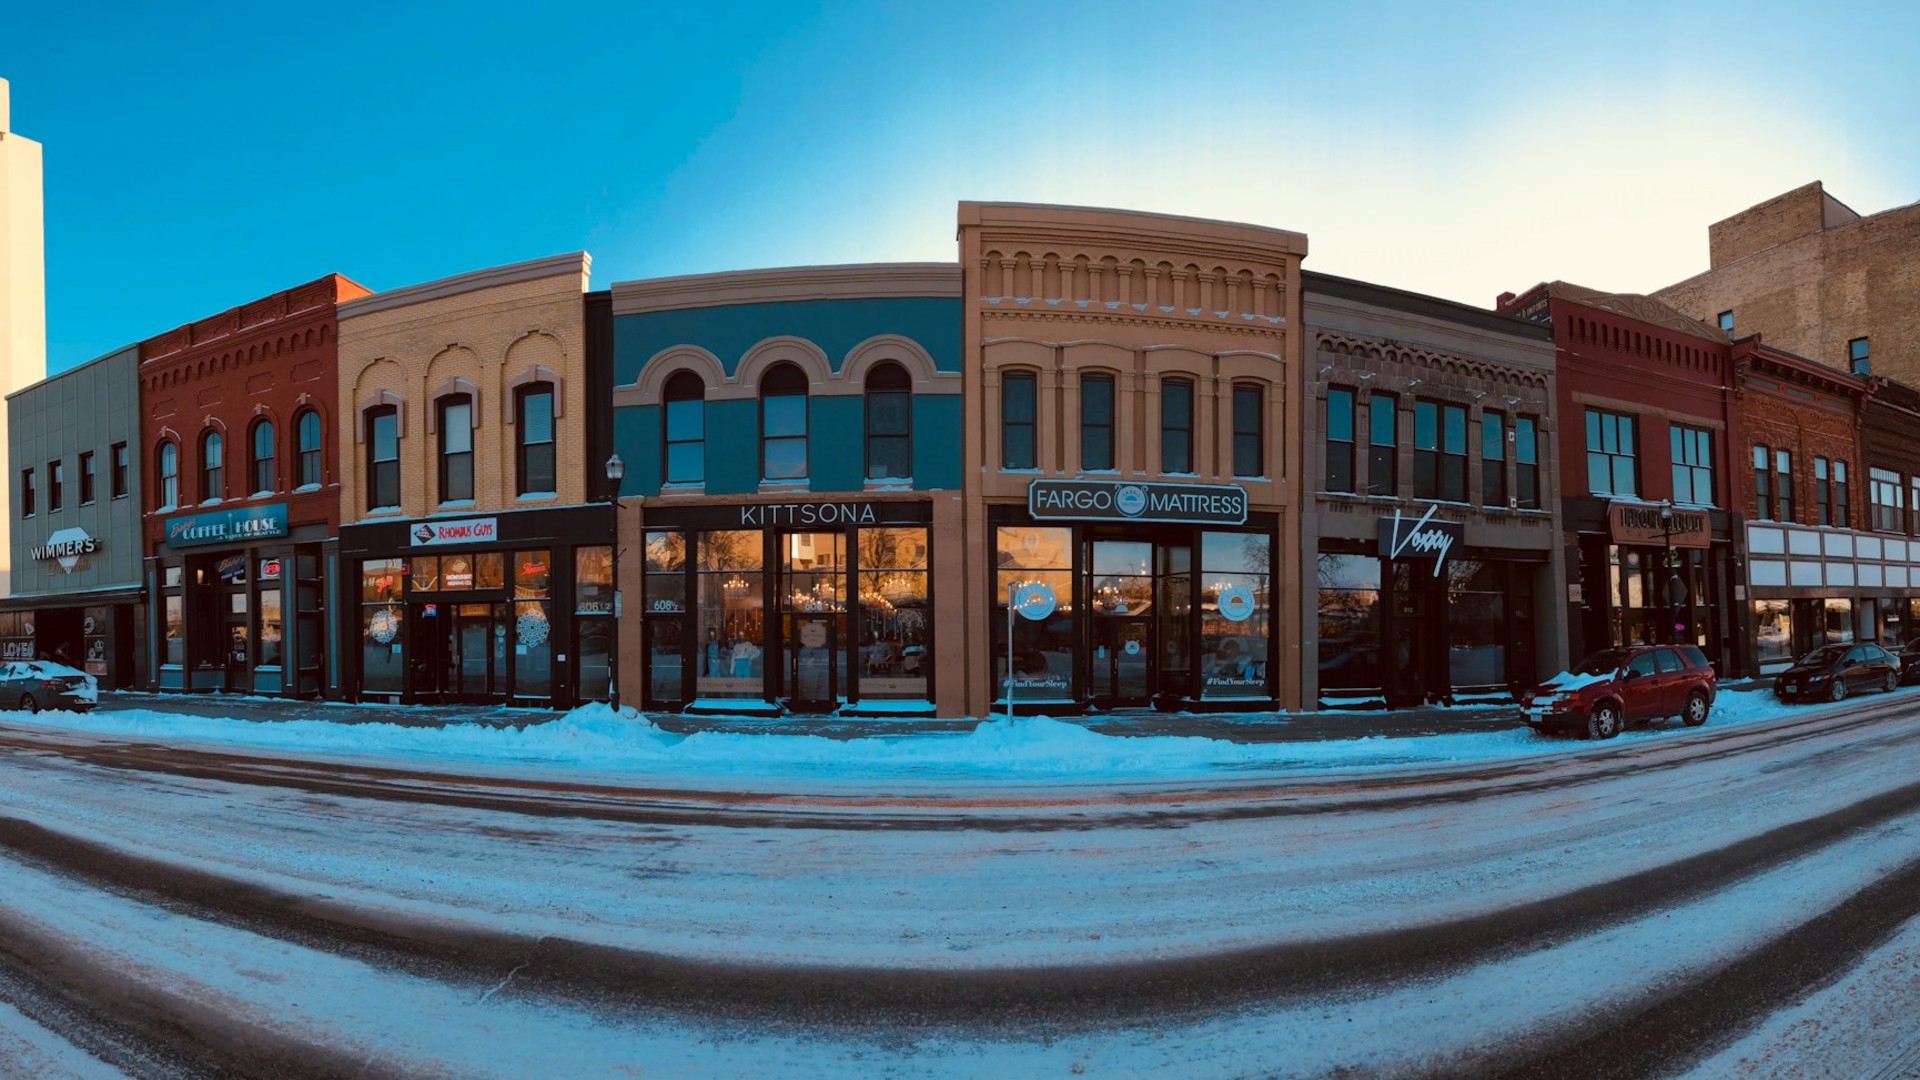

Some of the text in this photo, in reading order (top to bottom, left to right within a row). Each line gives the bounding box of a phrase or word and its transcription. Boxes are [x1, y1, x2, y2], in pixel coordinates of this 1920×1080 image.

[1037, 490, 1242, 514] FARGO MATTRESS
[741, 503, 876, 525] KITTSONA
[182, 517, 278, 540] COFFEE HOUSE
[438, 525, 472, 540] RHOMBUS
[30, 538, 96, 561] WIMMER'S
[1390, 503, 1455, 578] Voxxy
[579, 602, 600, 612] 606
